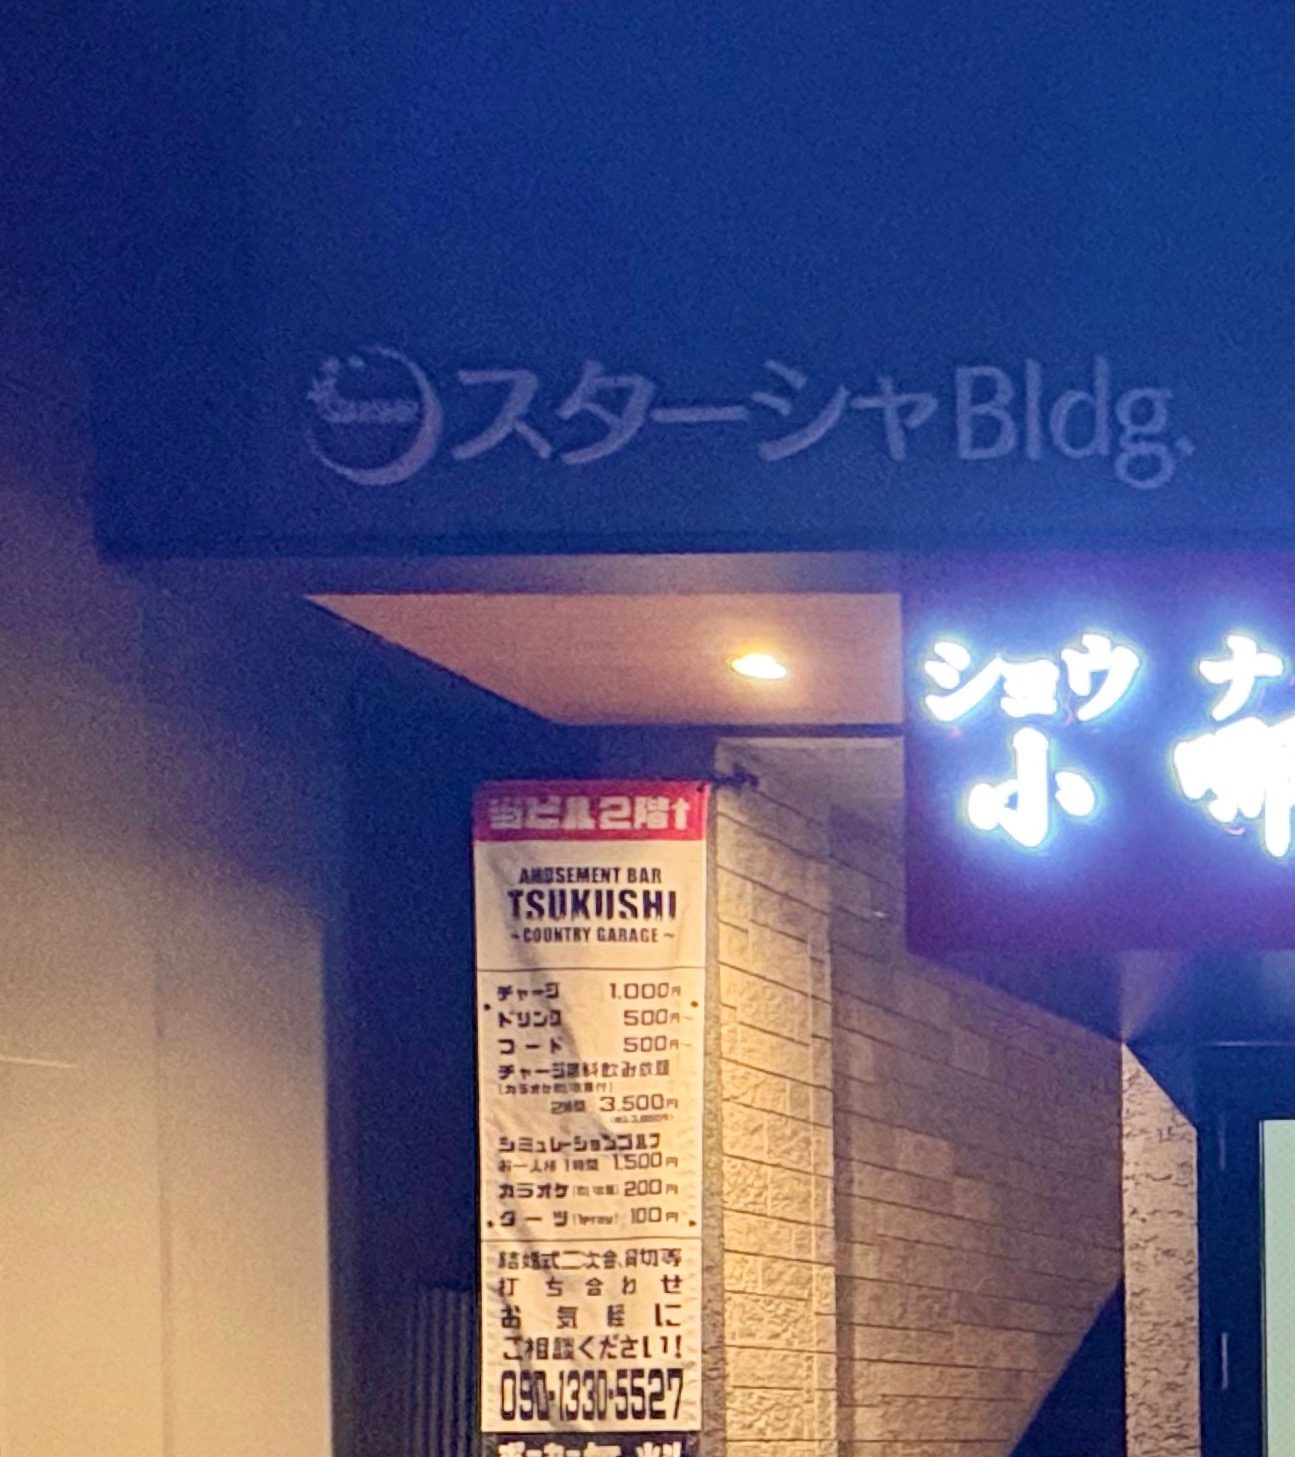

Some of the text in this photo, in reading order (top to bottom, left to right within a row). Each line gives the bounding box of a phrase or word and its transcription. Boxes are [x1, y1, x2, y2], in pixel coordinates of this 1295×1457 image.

[519, 867, 662, 884] AMUSEMENT BAR
[497, 1009, 562, 1028] ドリンク
[499, 1182, 569, 1199] カラオケ
